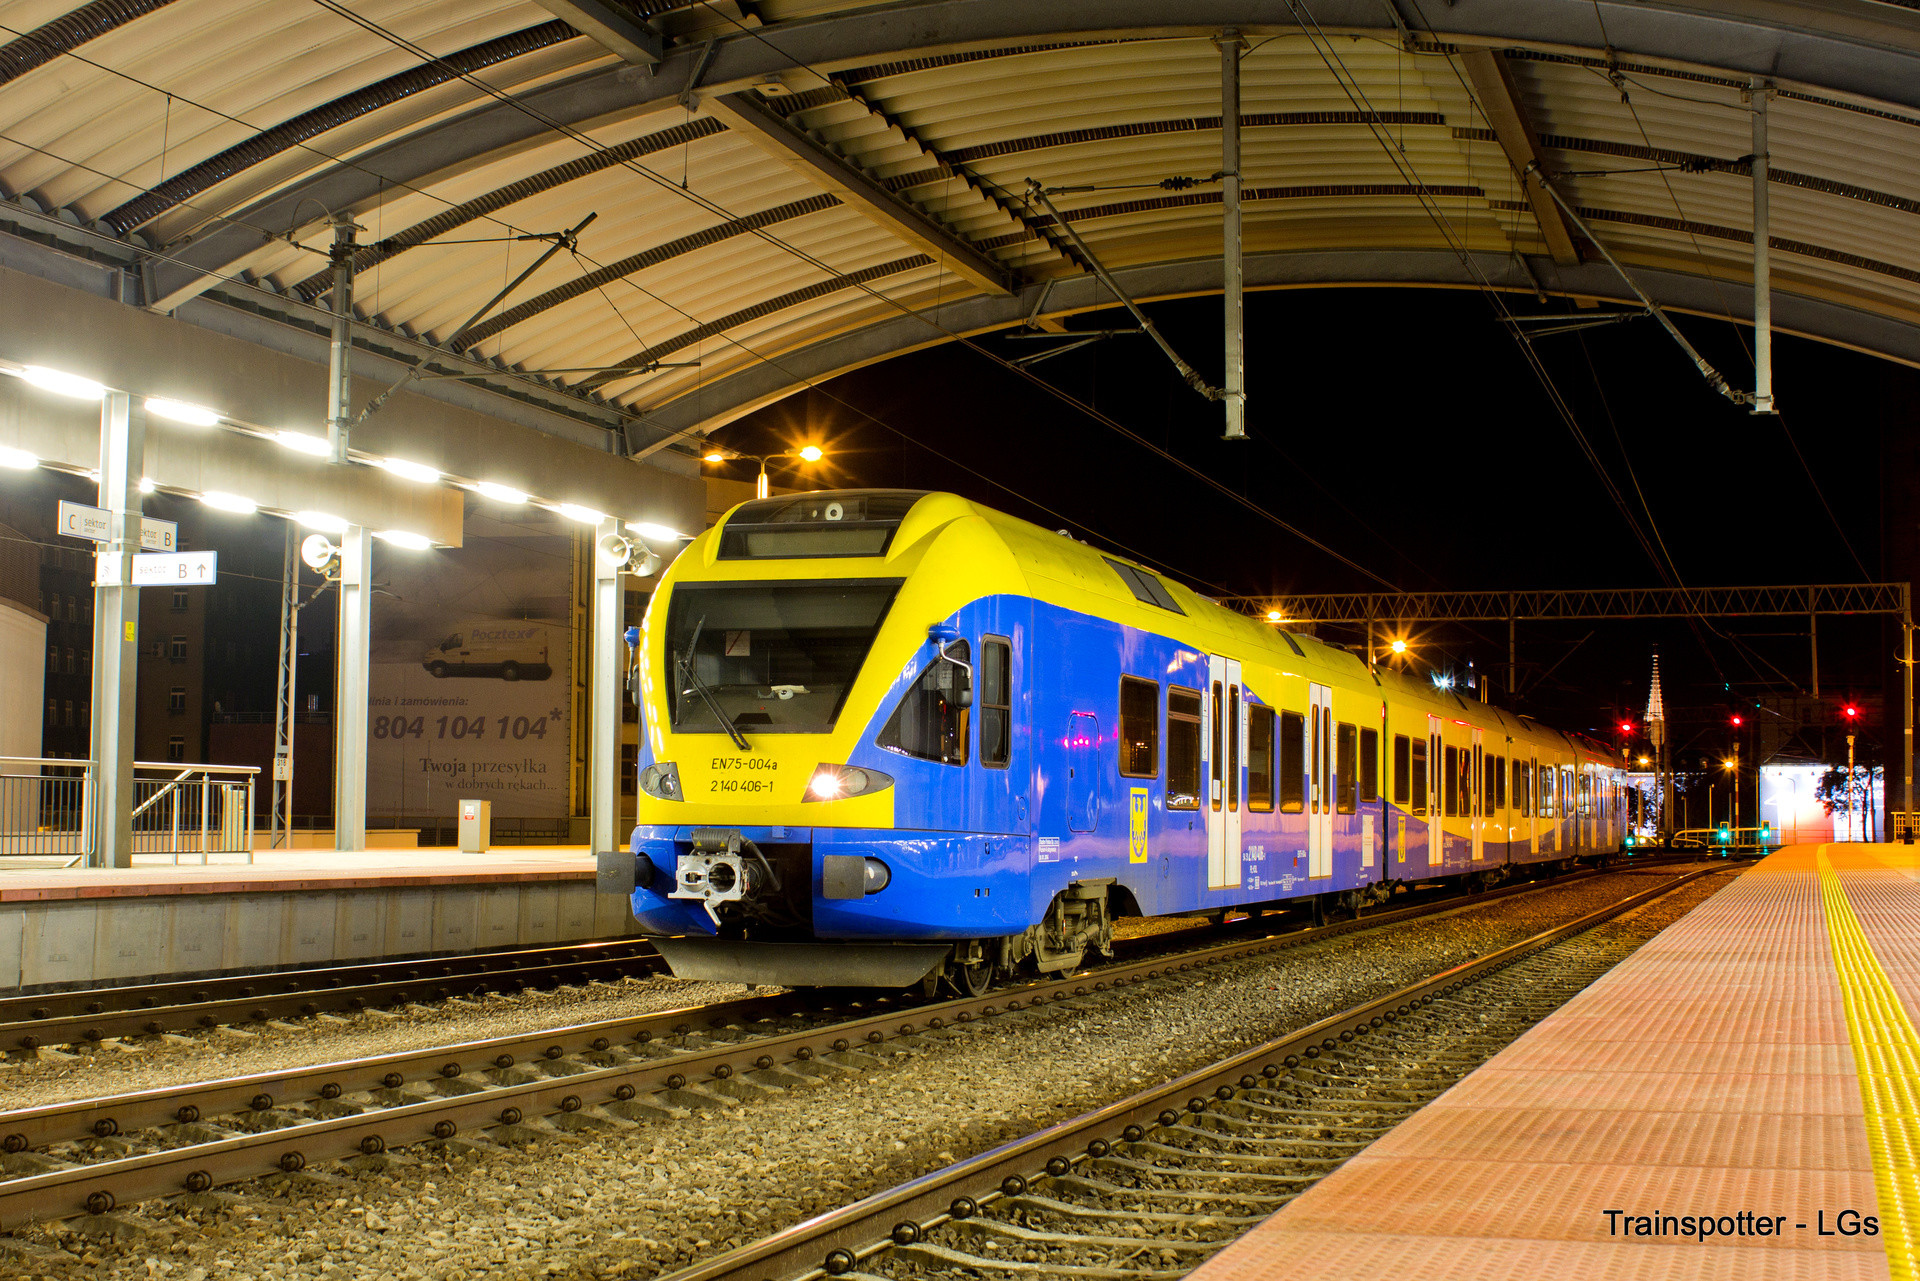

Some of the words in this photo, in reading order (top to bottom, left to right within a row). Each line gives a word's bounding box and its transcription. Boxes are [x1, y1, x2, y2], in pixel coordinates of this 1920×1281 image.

[68, 514, 77, 530] C
[84, 518, 107, 530] sektor
[140, 529, 157, 539] ektor
[165, 532, 172, 547] B
[178, 564, 188, 578] B
[471, 629, 525, 641] Pocztex
[400, 696, 469, 706] zamówienia:
[373, 716, 424, 739] 804
[436, 716, 485, 739] 104
[419, 758, 466, 777] Twoja
[472, 759, 547, 778] przesyłka
[711, 758, 778, 770] EN75-004a
[445, 780, 453, 789] w
[457, 778, 504, 793] dobrych
[508, 779, 557, 791] rękach...
[740, 780, 773, 792] 406-1
